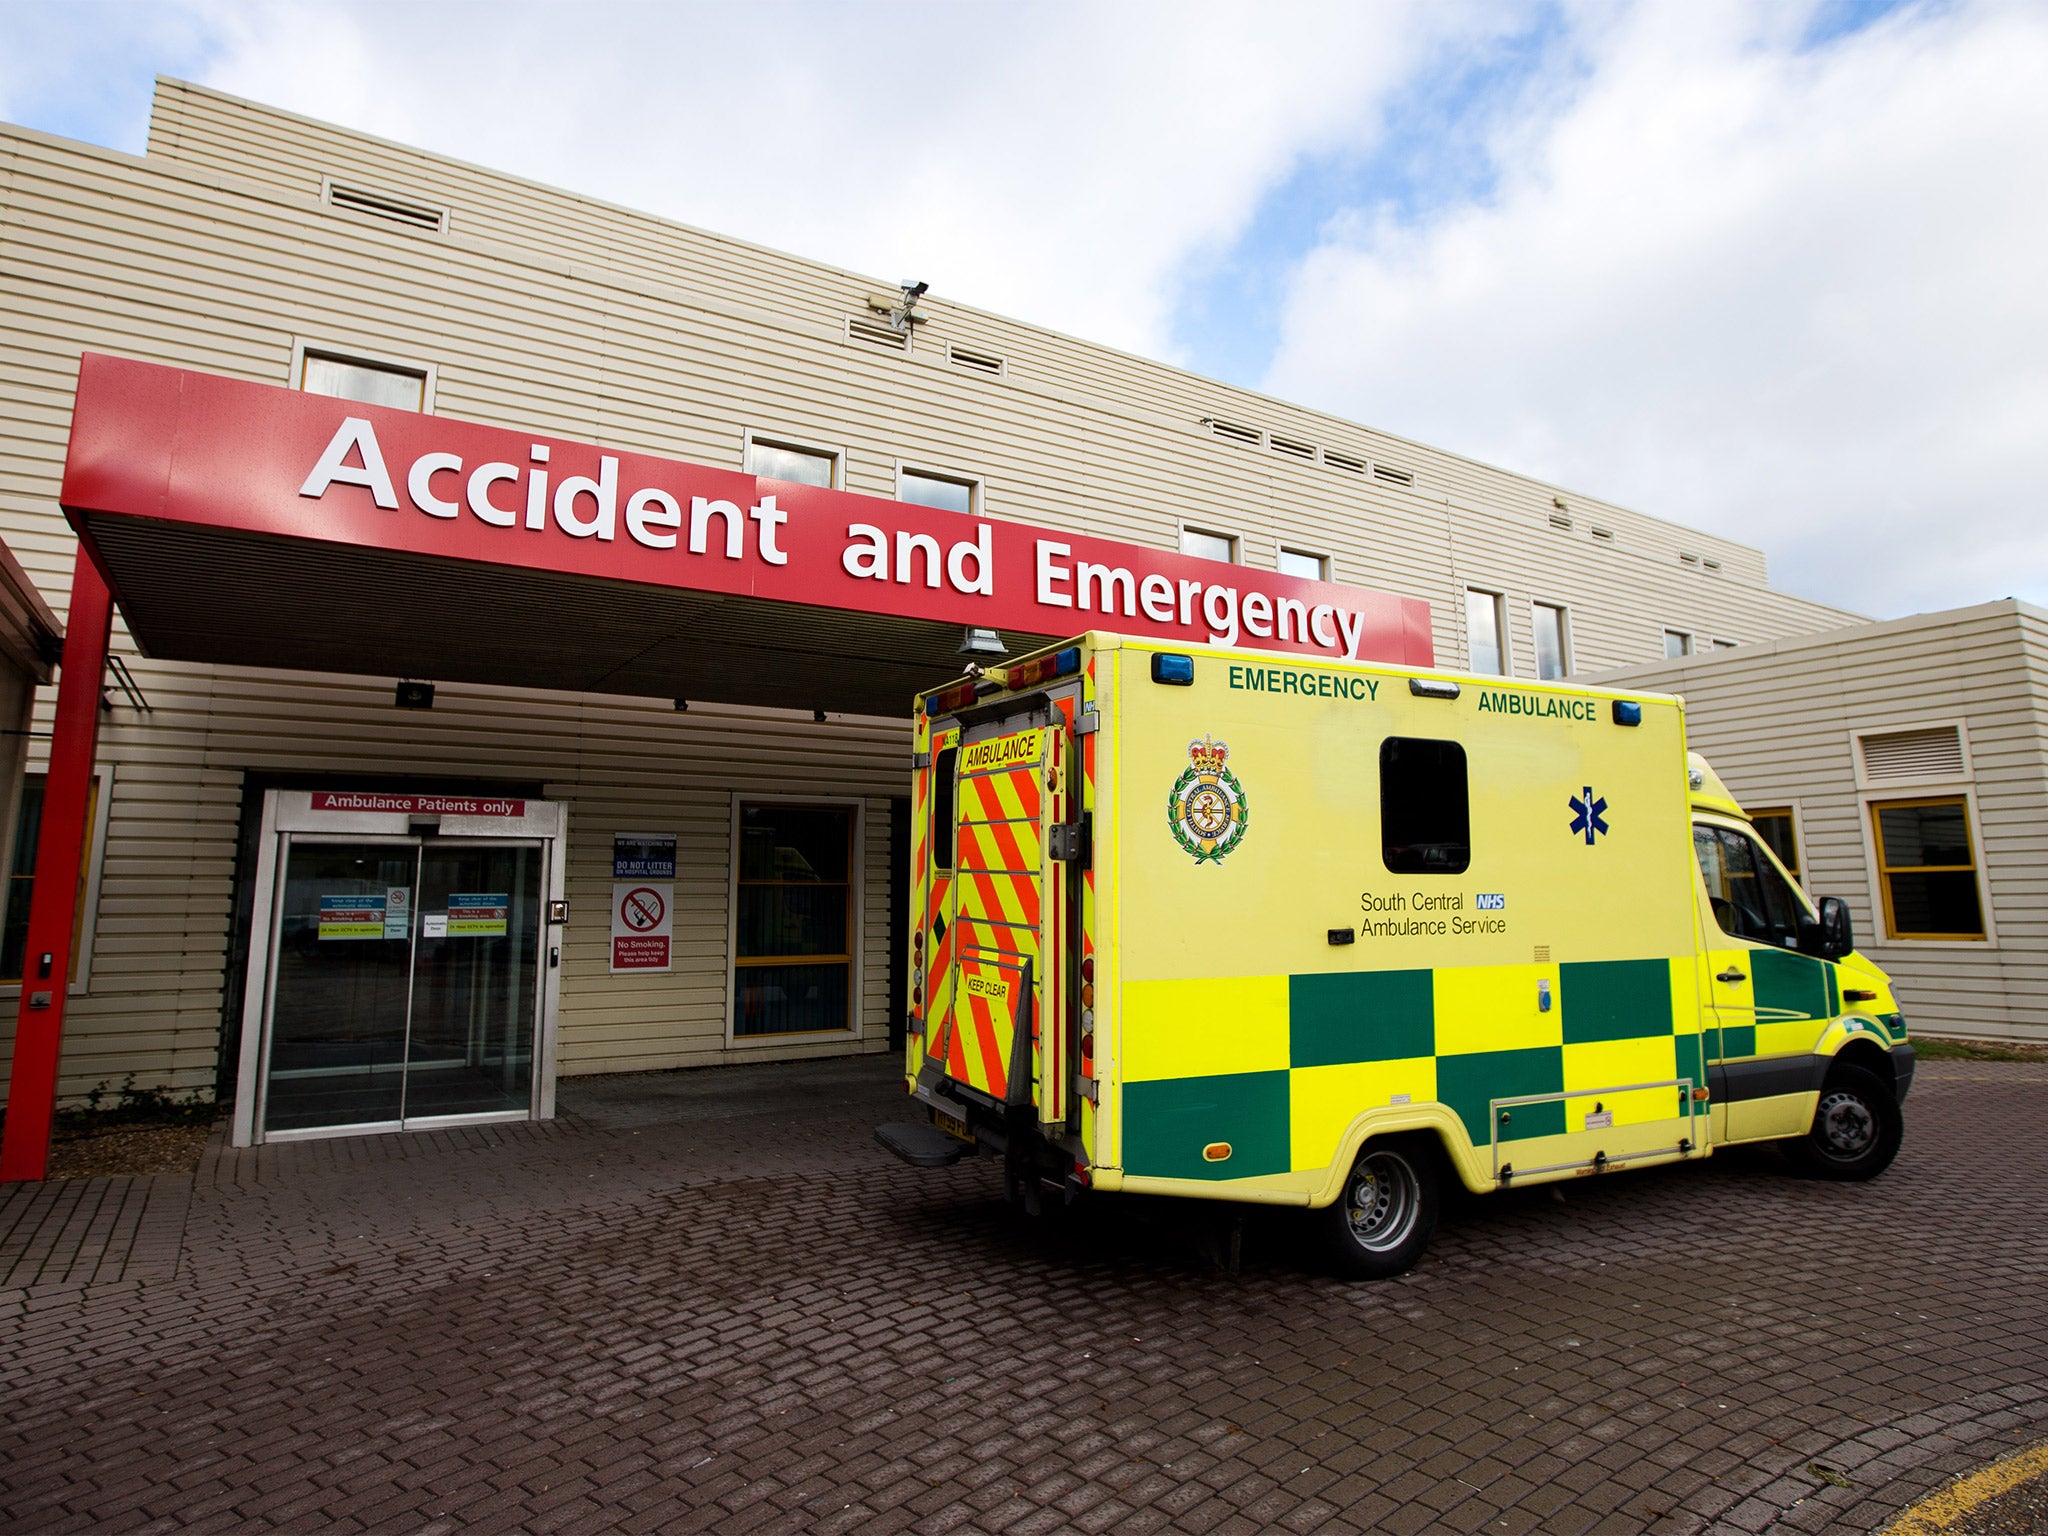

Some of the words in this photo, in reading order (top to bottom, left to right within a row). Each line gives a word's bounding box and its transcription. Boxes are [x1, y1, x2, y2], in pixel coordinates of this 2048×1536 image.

[299, 416, 789, 567] Accident
[842, 521, 994, 597] and
[1036, 539, 1366, 661] Emergency
[1229, 666, 1380, 701] EMERGENCY
[1478, 692, 1596, 721] AMBULANCE
[966, 734, 1036, 768] AMBULANCE
[325, 794, 411, 810] Ambulance
[418, 798, 477, 812] Patients
[483, 800, 514, 816] only
[616, 861, 628, 869] DO
[630, 861, 645, 869] NOT
[647, 861, 673, 870] LITTER
[1361, 892, 1407, 912] South
[1412, 892, 1464, 911] Central
[1477, 894, 1504, 909] NHS
[1361, 918, 1447, 937] Ambulance
[1452, 916, 1506, 934] Service
[617, 941, 630, 949] No
[630, 940, 666, 950] Smoking.
[650, 949, 665, 957] keep
[968, 977, 984, 993] KEEP
[985, 982, 1007, 999] CLEAR
